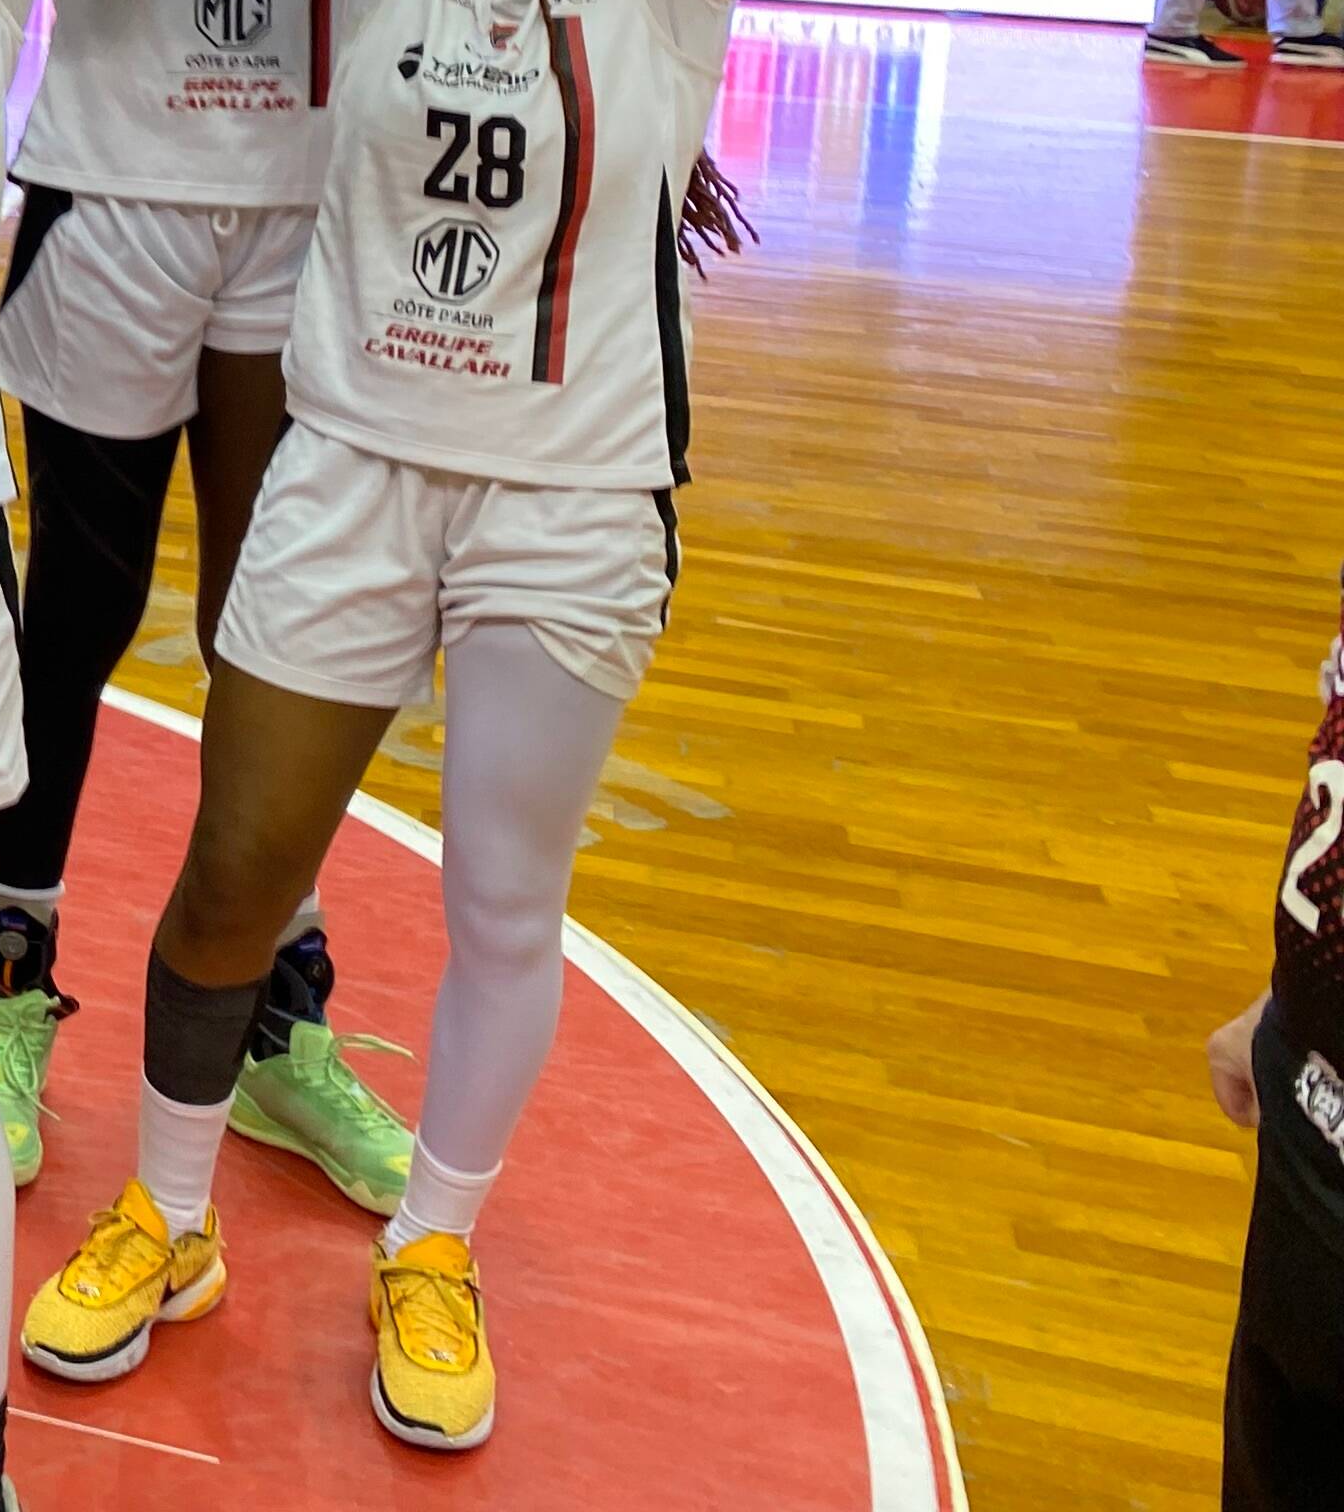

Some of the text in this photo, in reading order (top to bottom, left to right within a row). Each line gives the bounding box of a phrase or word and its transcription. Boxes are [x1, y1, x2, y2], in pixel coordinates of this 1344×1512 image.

[423, 106, 528, 209] 28
[419, 226, 493, 297] MG
[393, 297, 494, 330] CÔTE D'AZUR
[363, 337, 512, 380] CAVALLARI
[384, 321, 494, 355] GROUPE
